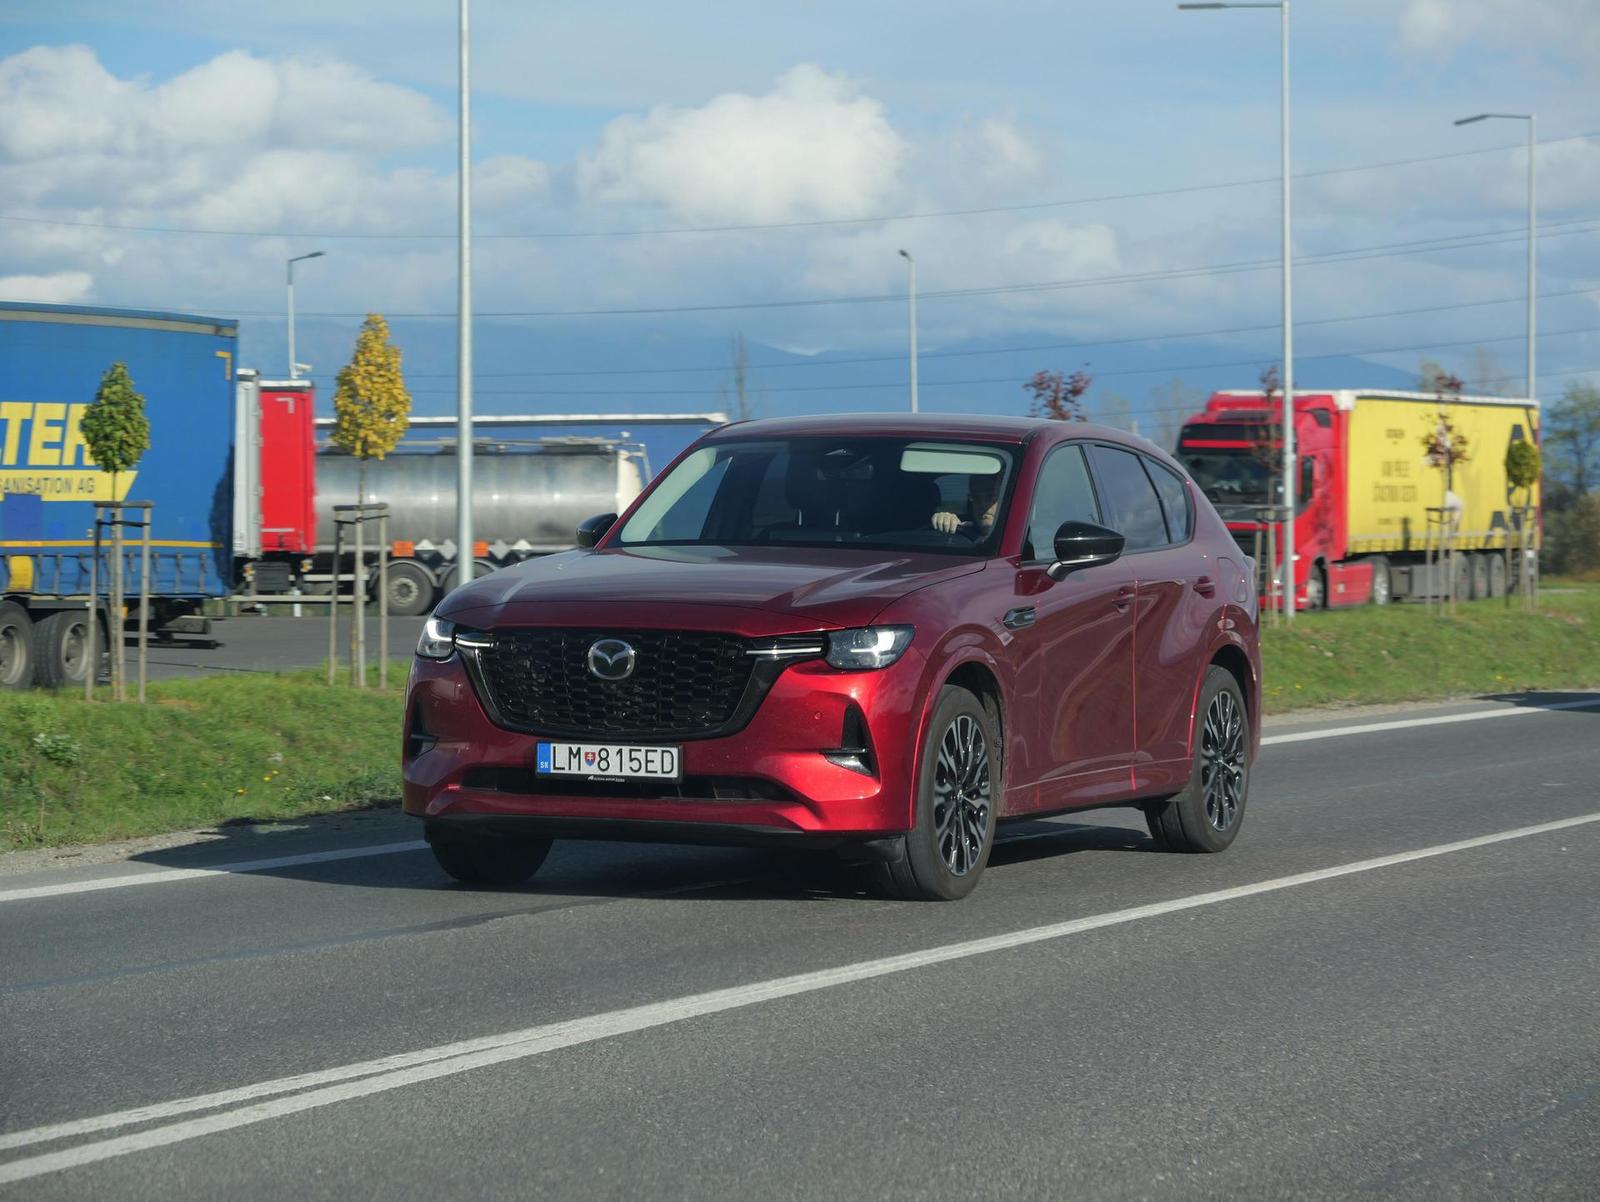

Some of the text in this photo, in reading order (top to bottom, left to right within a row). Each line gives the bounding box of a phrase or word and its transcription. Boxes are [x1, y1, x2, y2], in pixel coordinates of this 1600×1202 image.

[0, 402, 97, 466] TER
[0, 477, 96, 494] ANISATION AG
[540, 761, 549, 769] SK
[553, 746, 675, 775] LM 815ED
